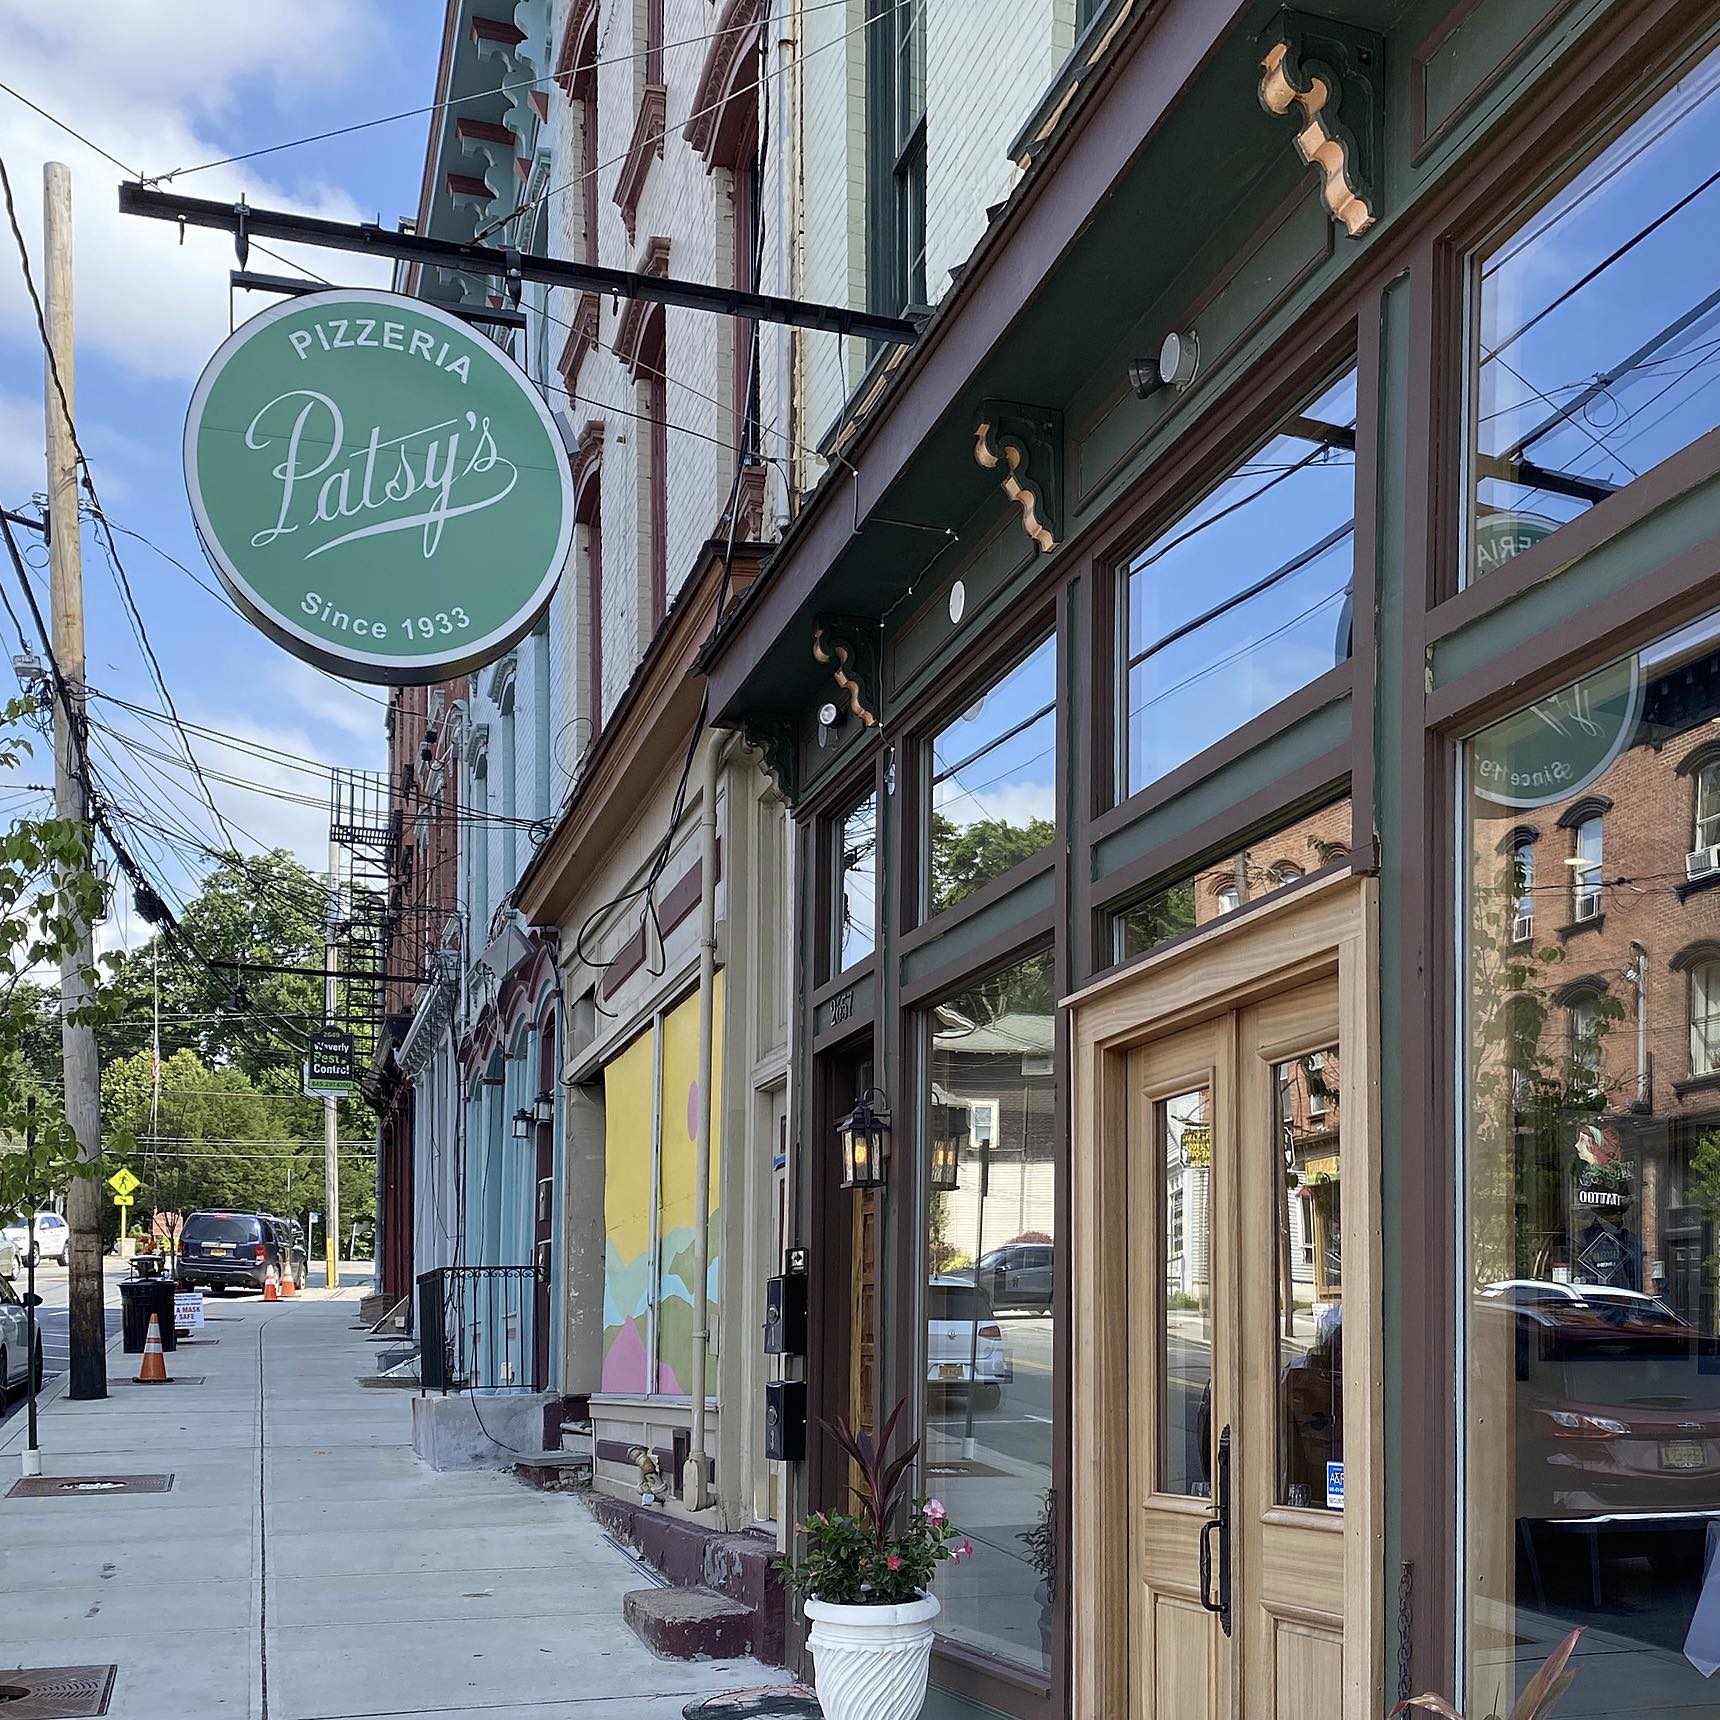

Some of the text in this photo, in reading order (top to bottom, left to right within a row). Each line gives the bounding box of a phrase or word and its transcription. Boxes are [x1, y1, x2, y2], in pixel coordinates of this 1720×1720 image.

[288, 319, 471, 385] PIZZERIA
[245, 389, 518, 561] Patsy's
[300, 592, 470, 640] Since 1933
[314, 1042, 349, 1053] Waverly
[314, 1052, 340, 1063] Pest
[313, 1063, 350, 1075] Control
